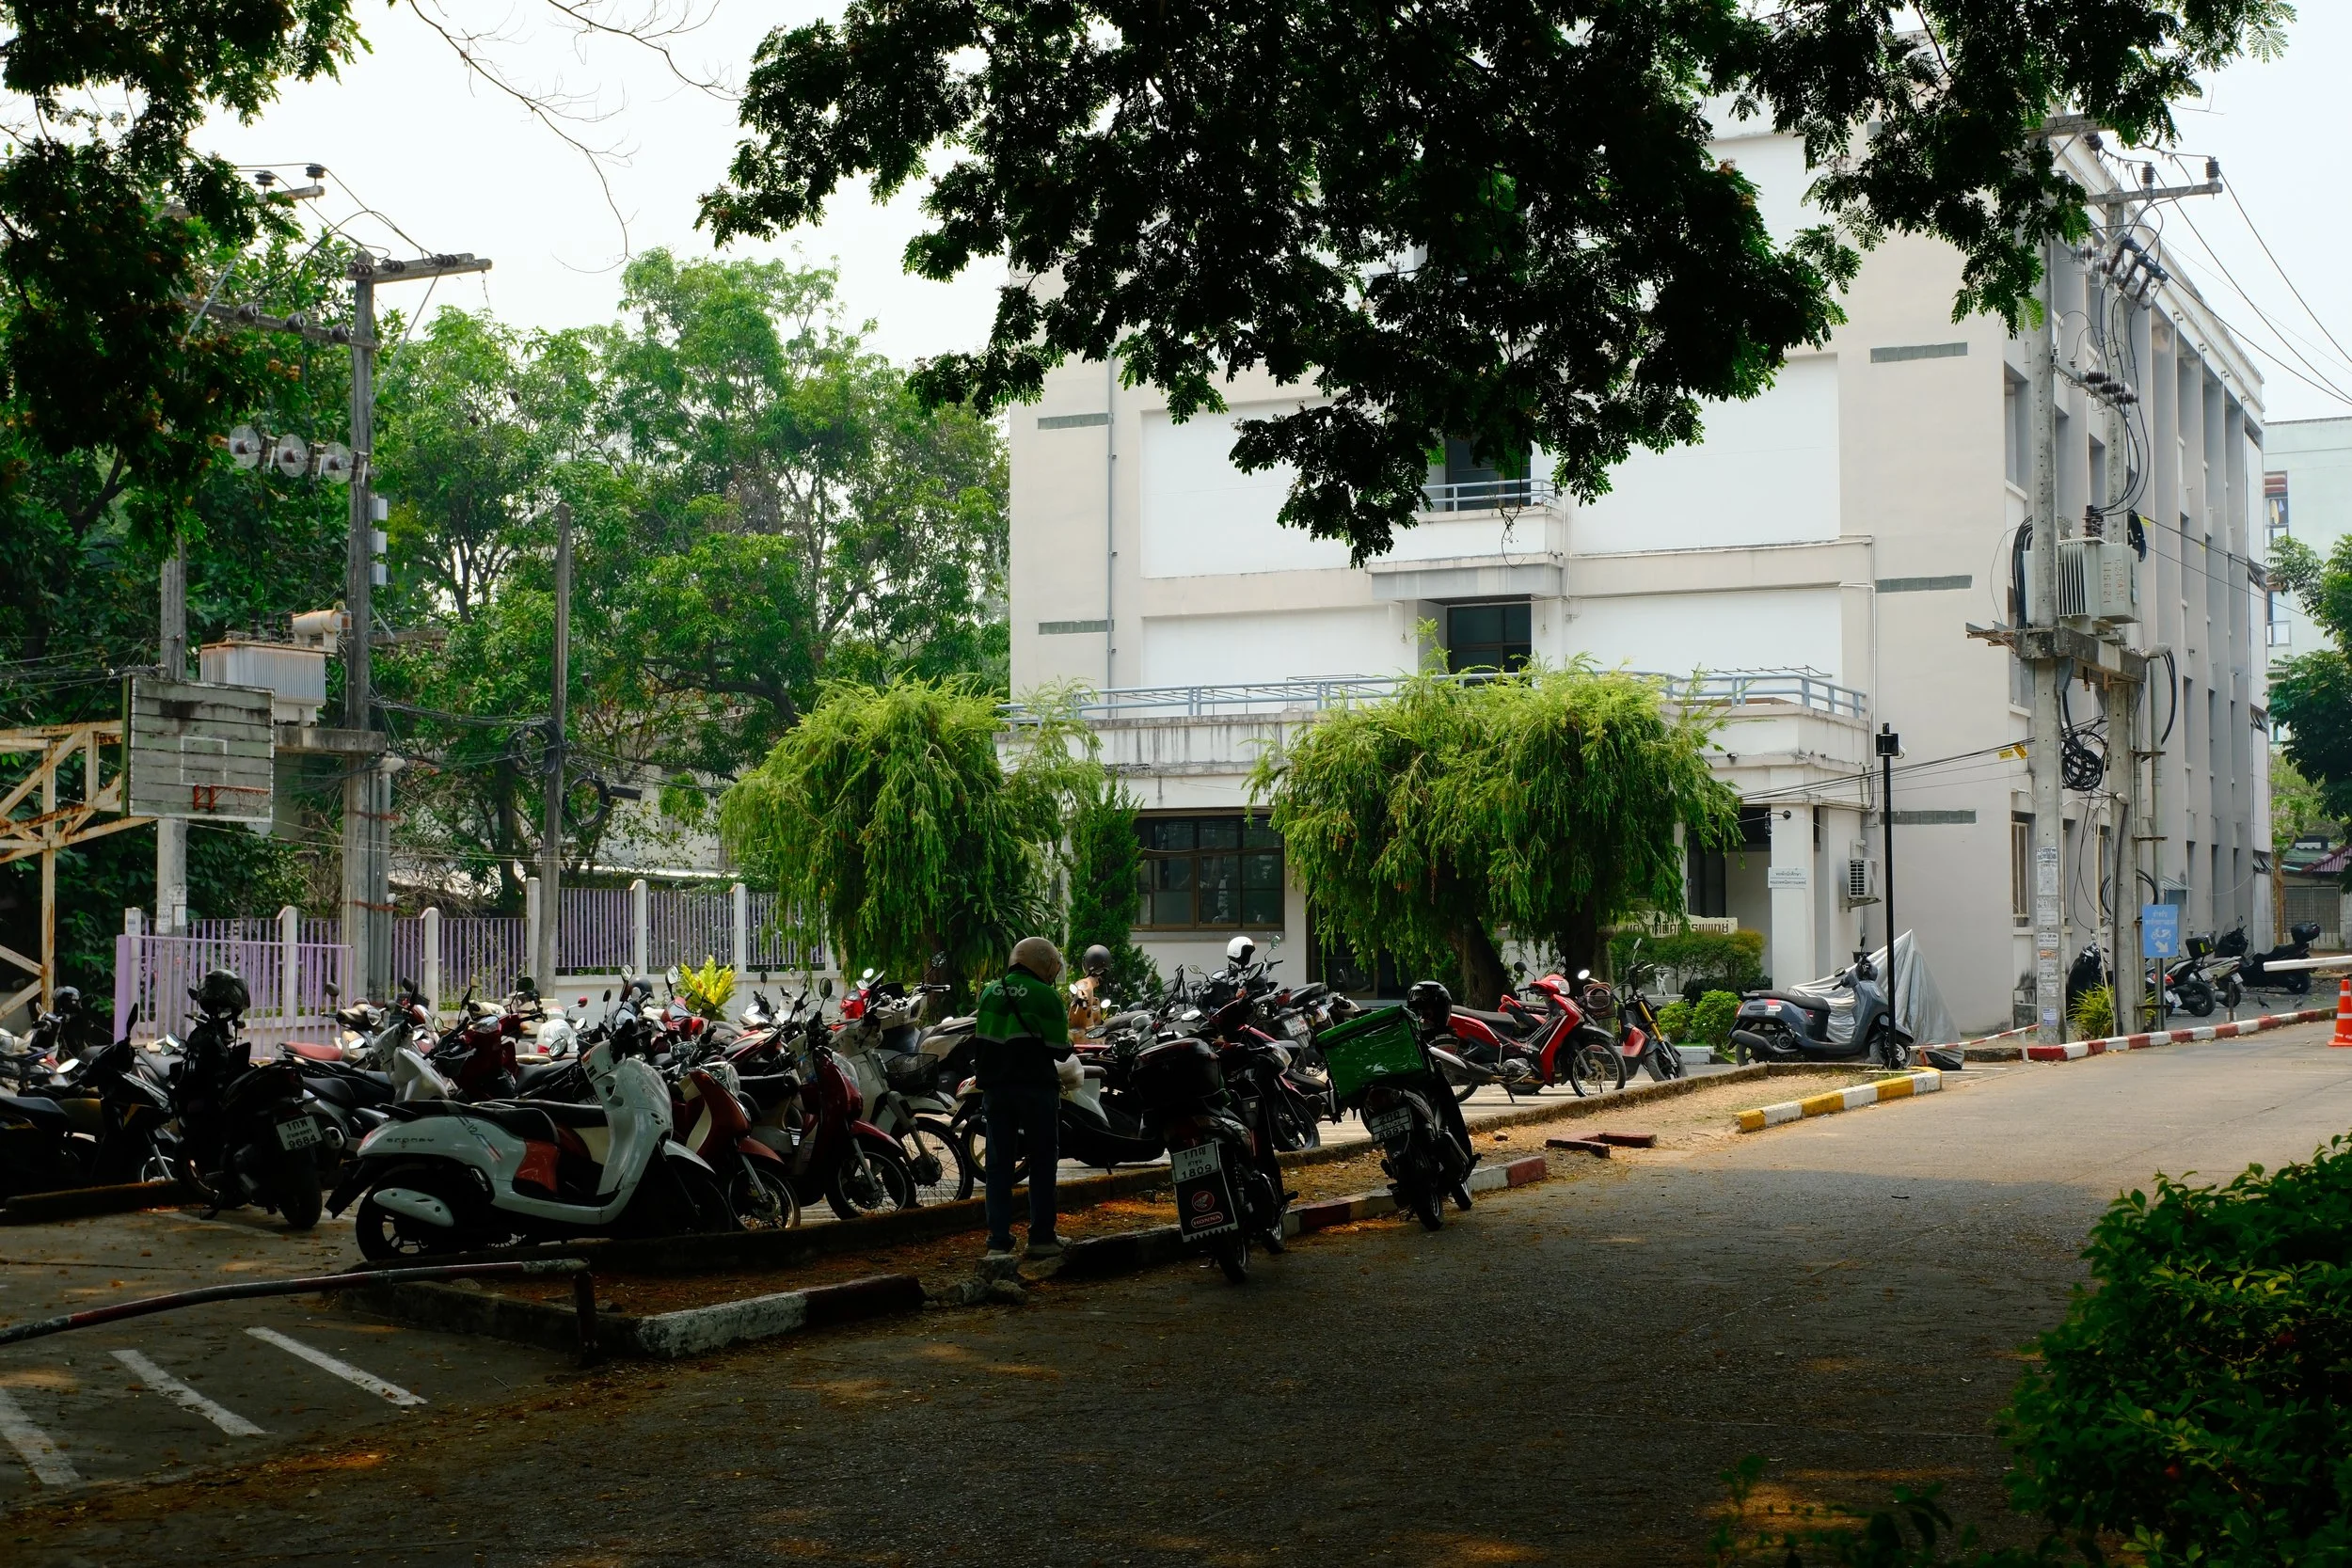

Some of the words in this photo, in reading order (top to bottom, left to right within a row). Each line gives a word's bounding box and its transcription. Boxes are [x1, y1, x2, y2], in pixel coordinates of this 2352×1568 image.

[993, 984, 1028, 997] Grab
[288, 1134, 317, 1148] 9684
[1182, 1164, 1213, 1179] 1809
